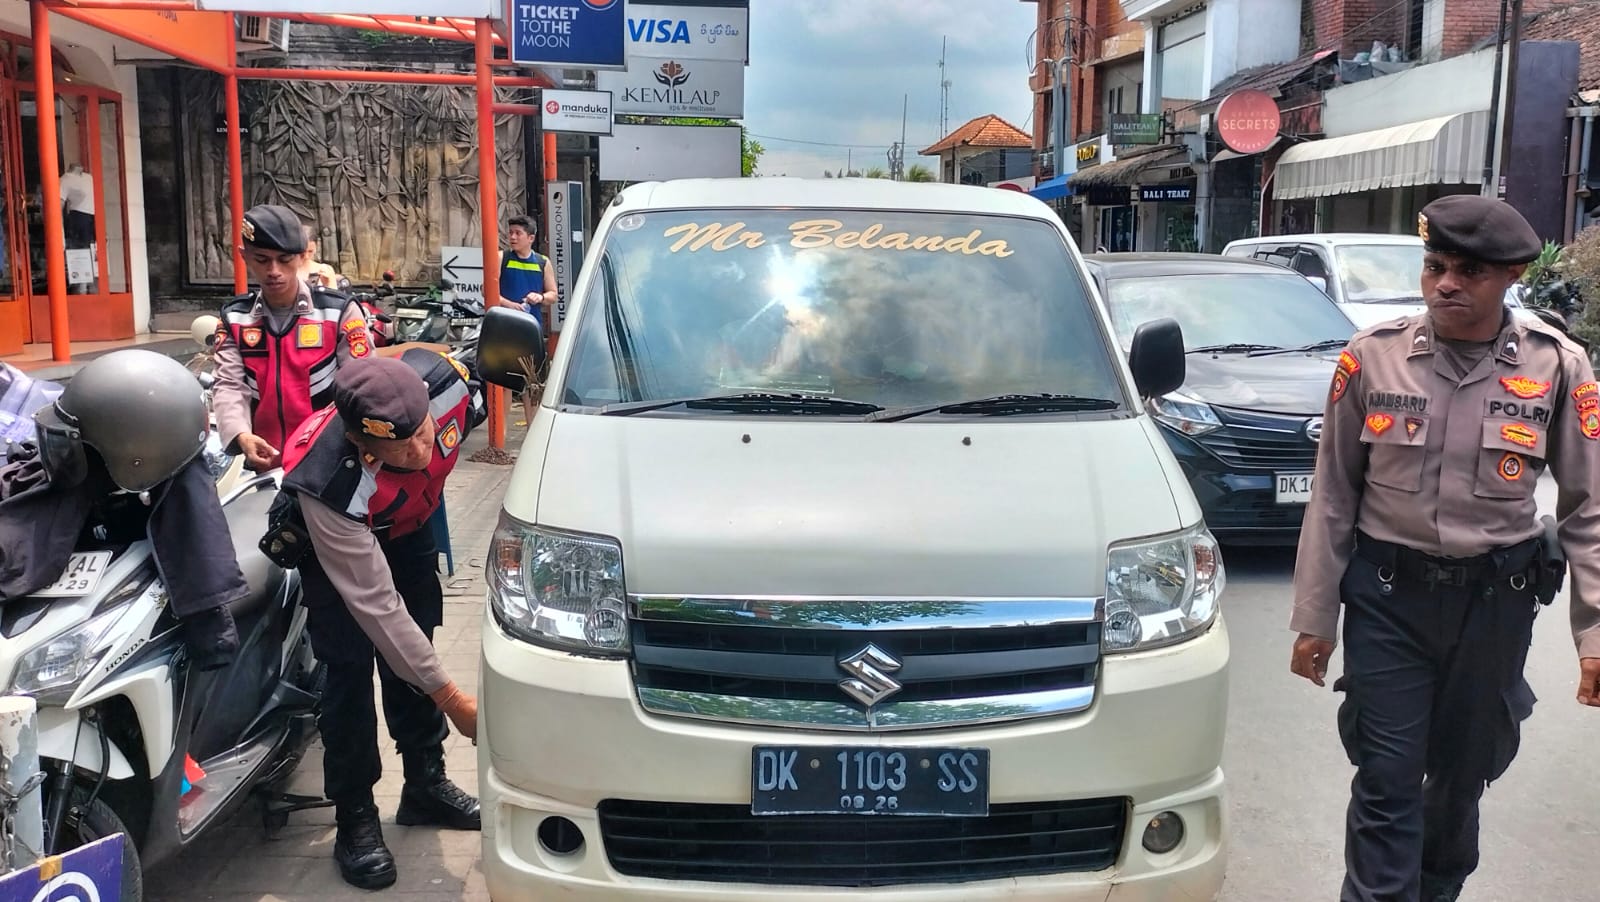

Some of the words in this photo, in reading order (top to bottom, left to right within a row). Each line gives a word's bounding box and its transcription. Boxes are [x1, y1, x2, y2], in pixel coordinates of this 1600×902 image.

[519, 5, 580, 20] TICKET
[627, 18, 691, 44] VISA
[520, 34, 570, 48] MOON
[621, 86, 720, 105] KEMILAU
[561, 104, 608, 114] manduka
[1113, 122, 1131, 130] BALI
[1222, 119, 1276, 130] SECRETS
[1143, 189, 1164, 199] BALI
[1167, 189, 1190, 198] TEAKY
[663, 221, 767, 253] Mr
[787, 219, 1014, 258] Belanda
[1489, 400, 1550, 424] POLRI
[1280, 477, 1299, 493] DK
[104, 638, 146, 673] HONDA
[758, 750, 798, 791] DK
[837, 750, 907, 791] 1103
[937, 751, 979, 793] SS
